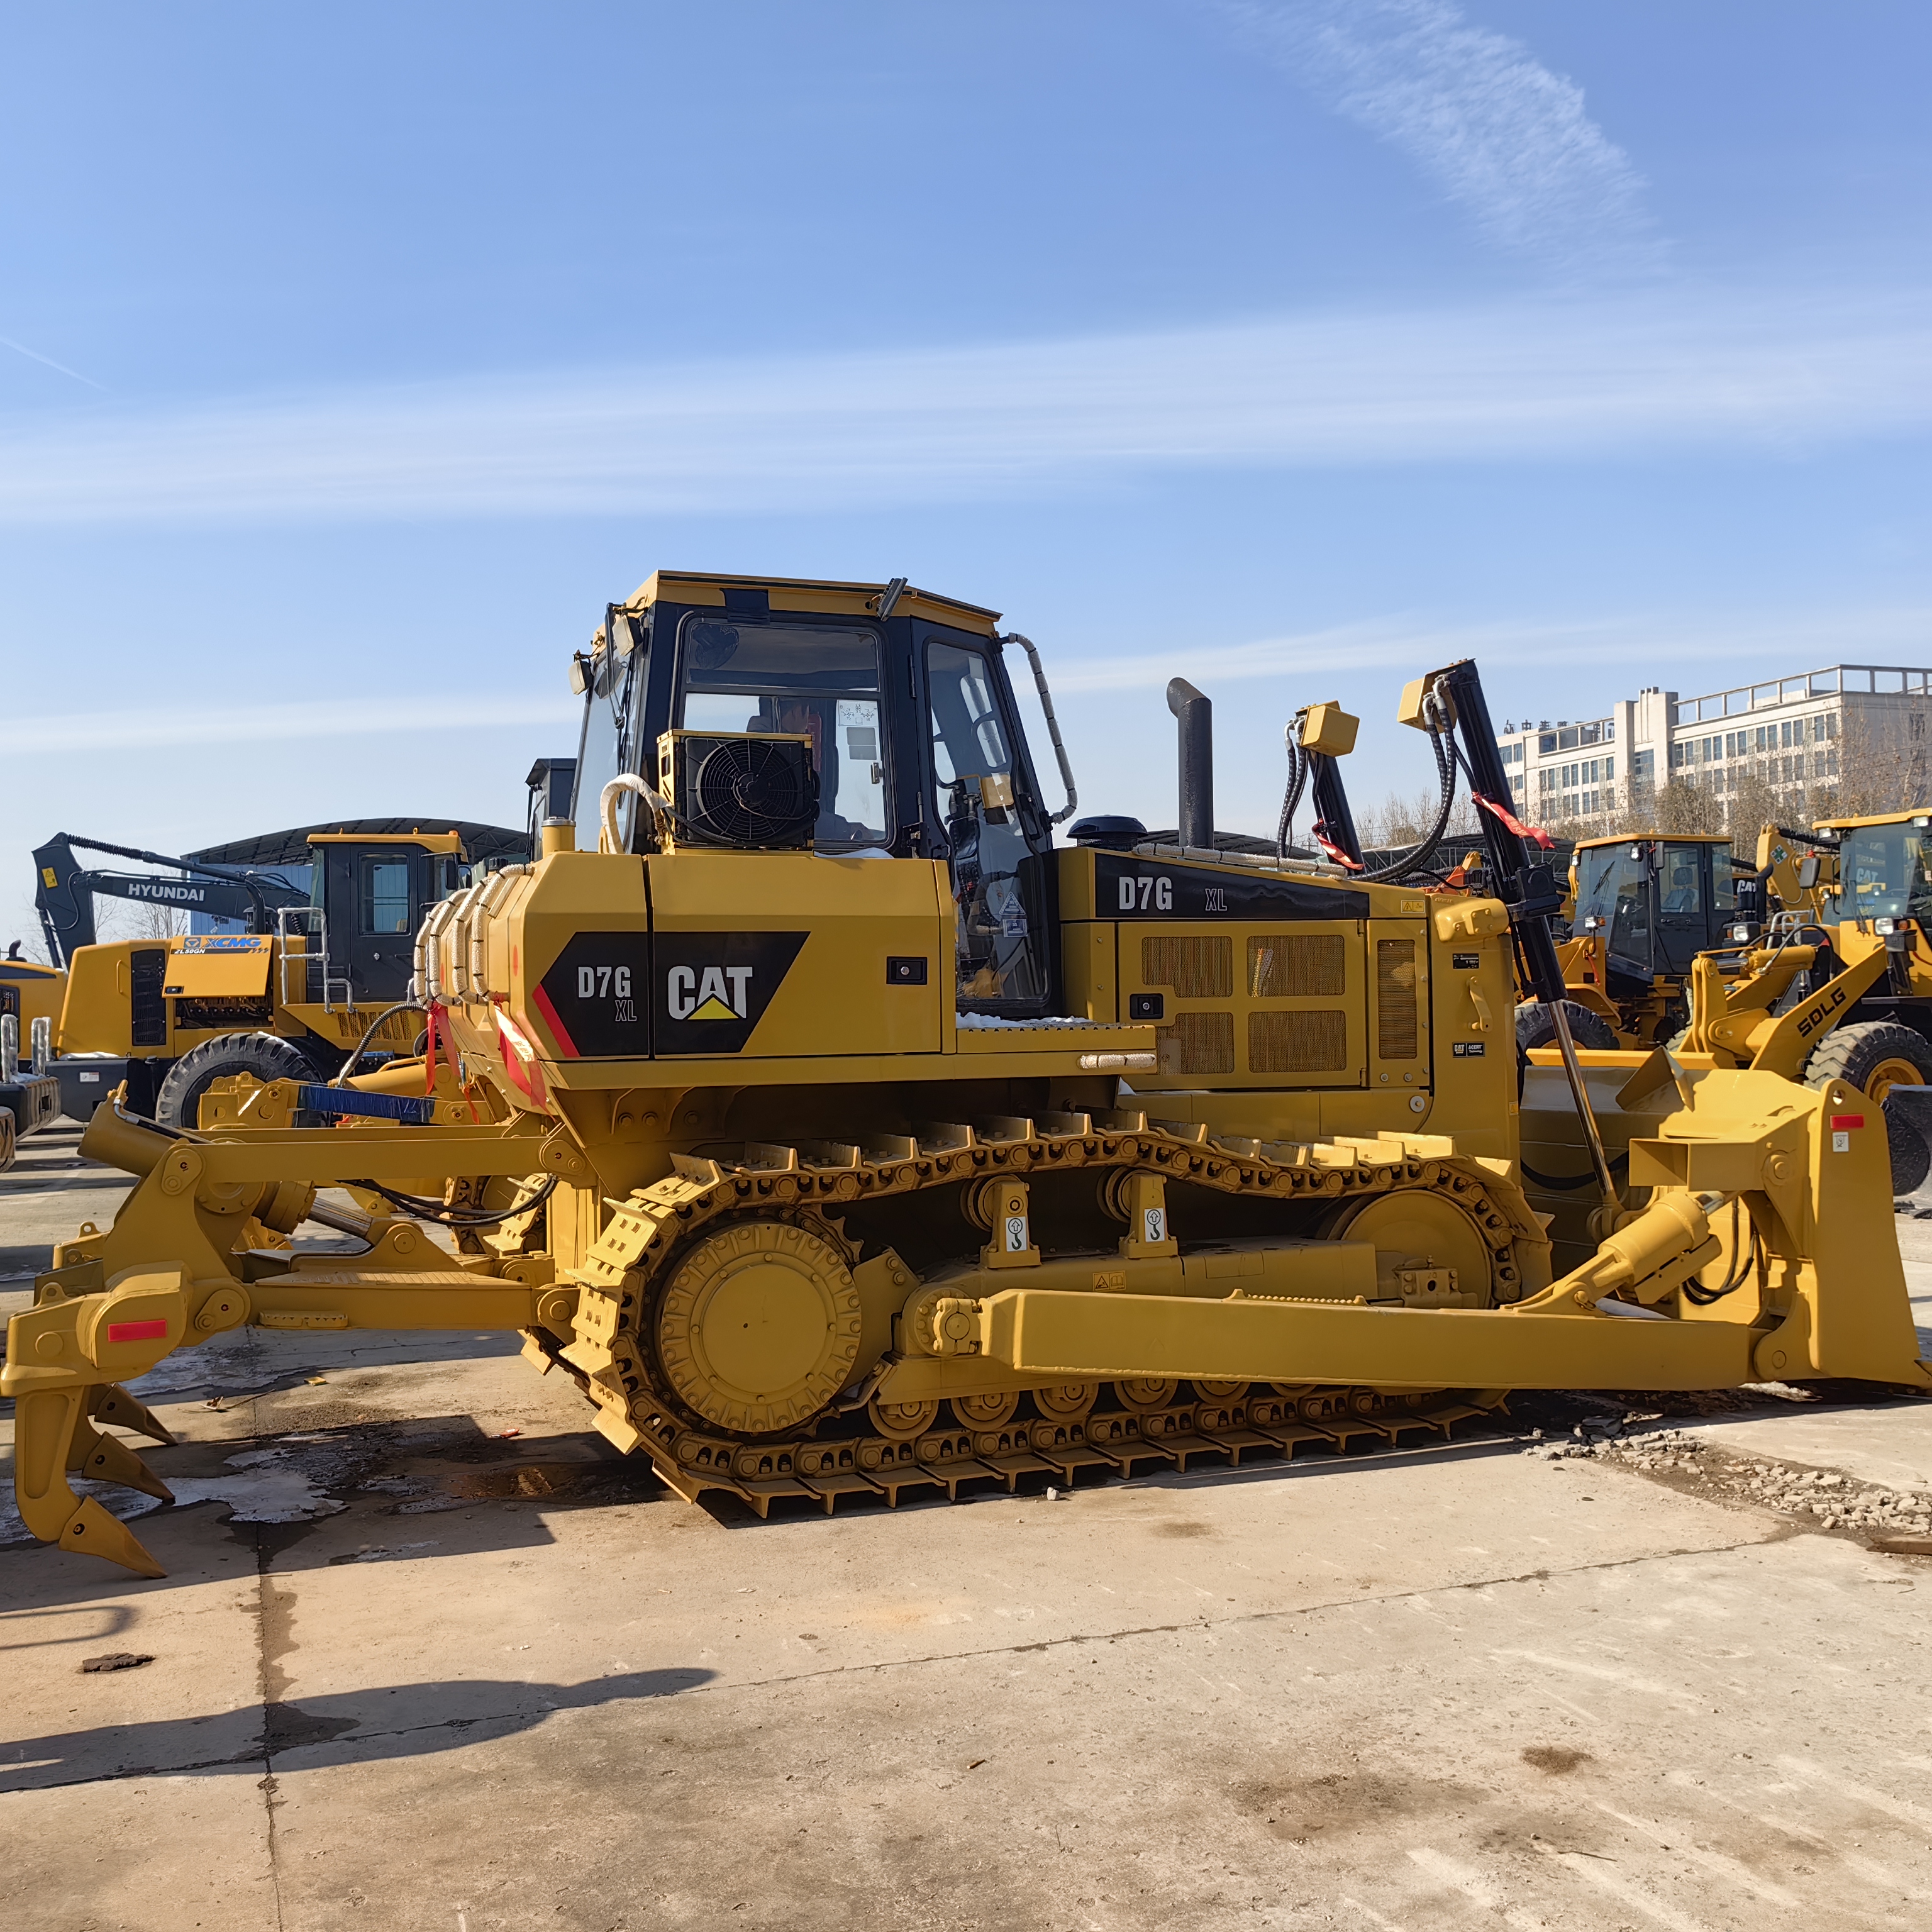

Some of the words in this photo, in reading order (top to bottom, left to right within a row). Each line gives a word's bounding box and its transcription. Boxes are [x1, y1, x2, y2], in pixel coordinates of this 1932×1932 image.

[1856, 867, 1879, 882] CAT
[128, 883, 205, 901] HYUNDAI
[1119, 877, 1172, 910] D7G
[1205, 888, 1228, 911] XL
[202, 937, 262, 948] XCMG
[578, 965, 631, 998] D7G
[668, 965, 753, 1020] CAT
[614, 999, 637, 1021] XL
[1797, 986, 1846, 1038] SDLG
